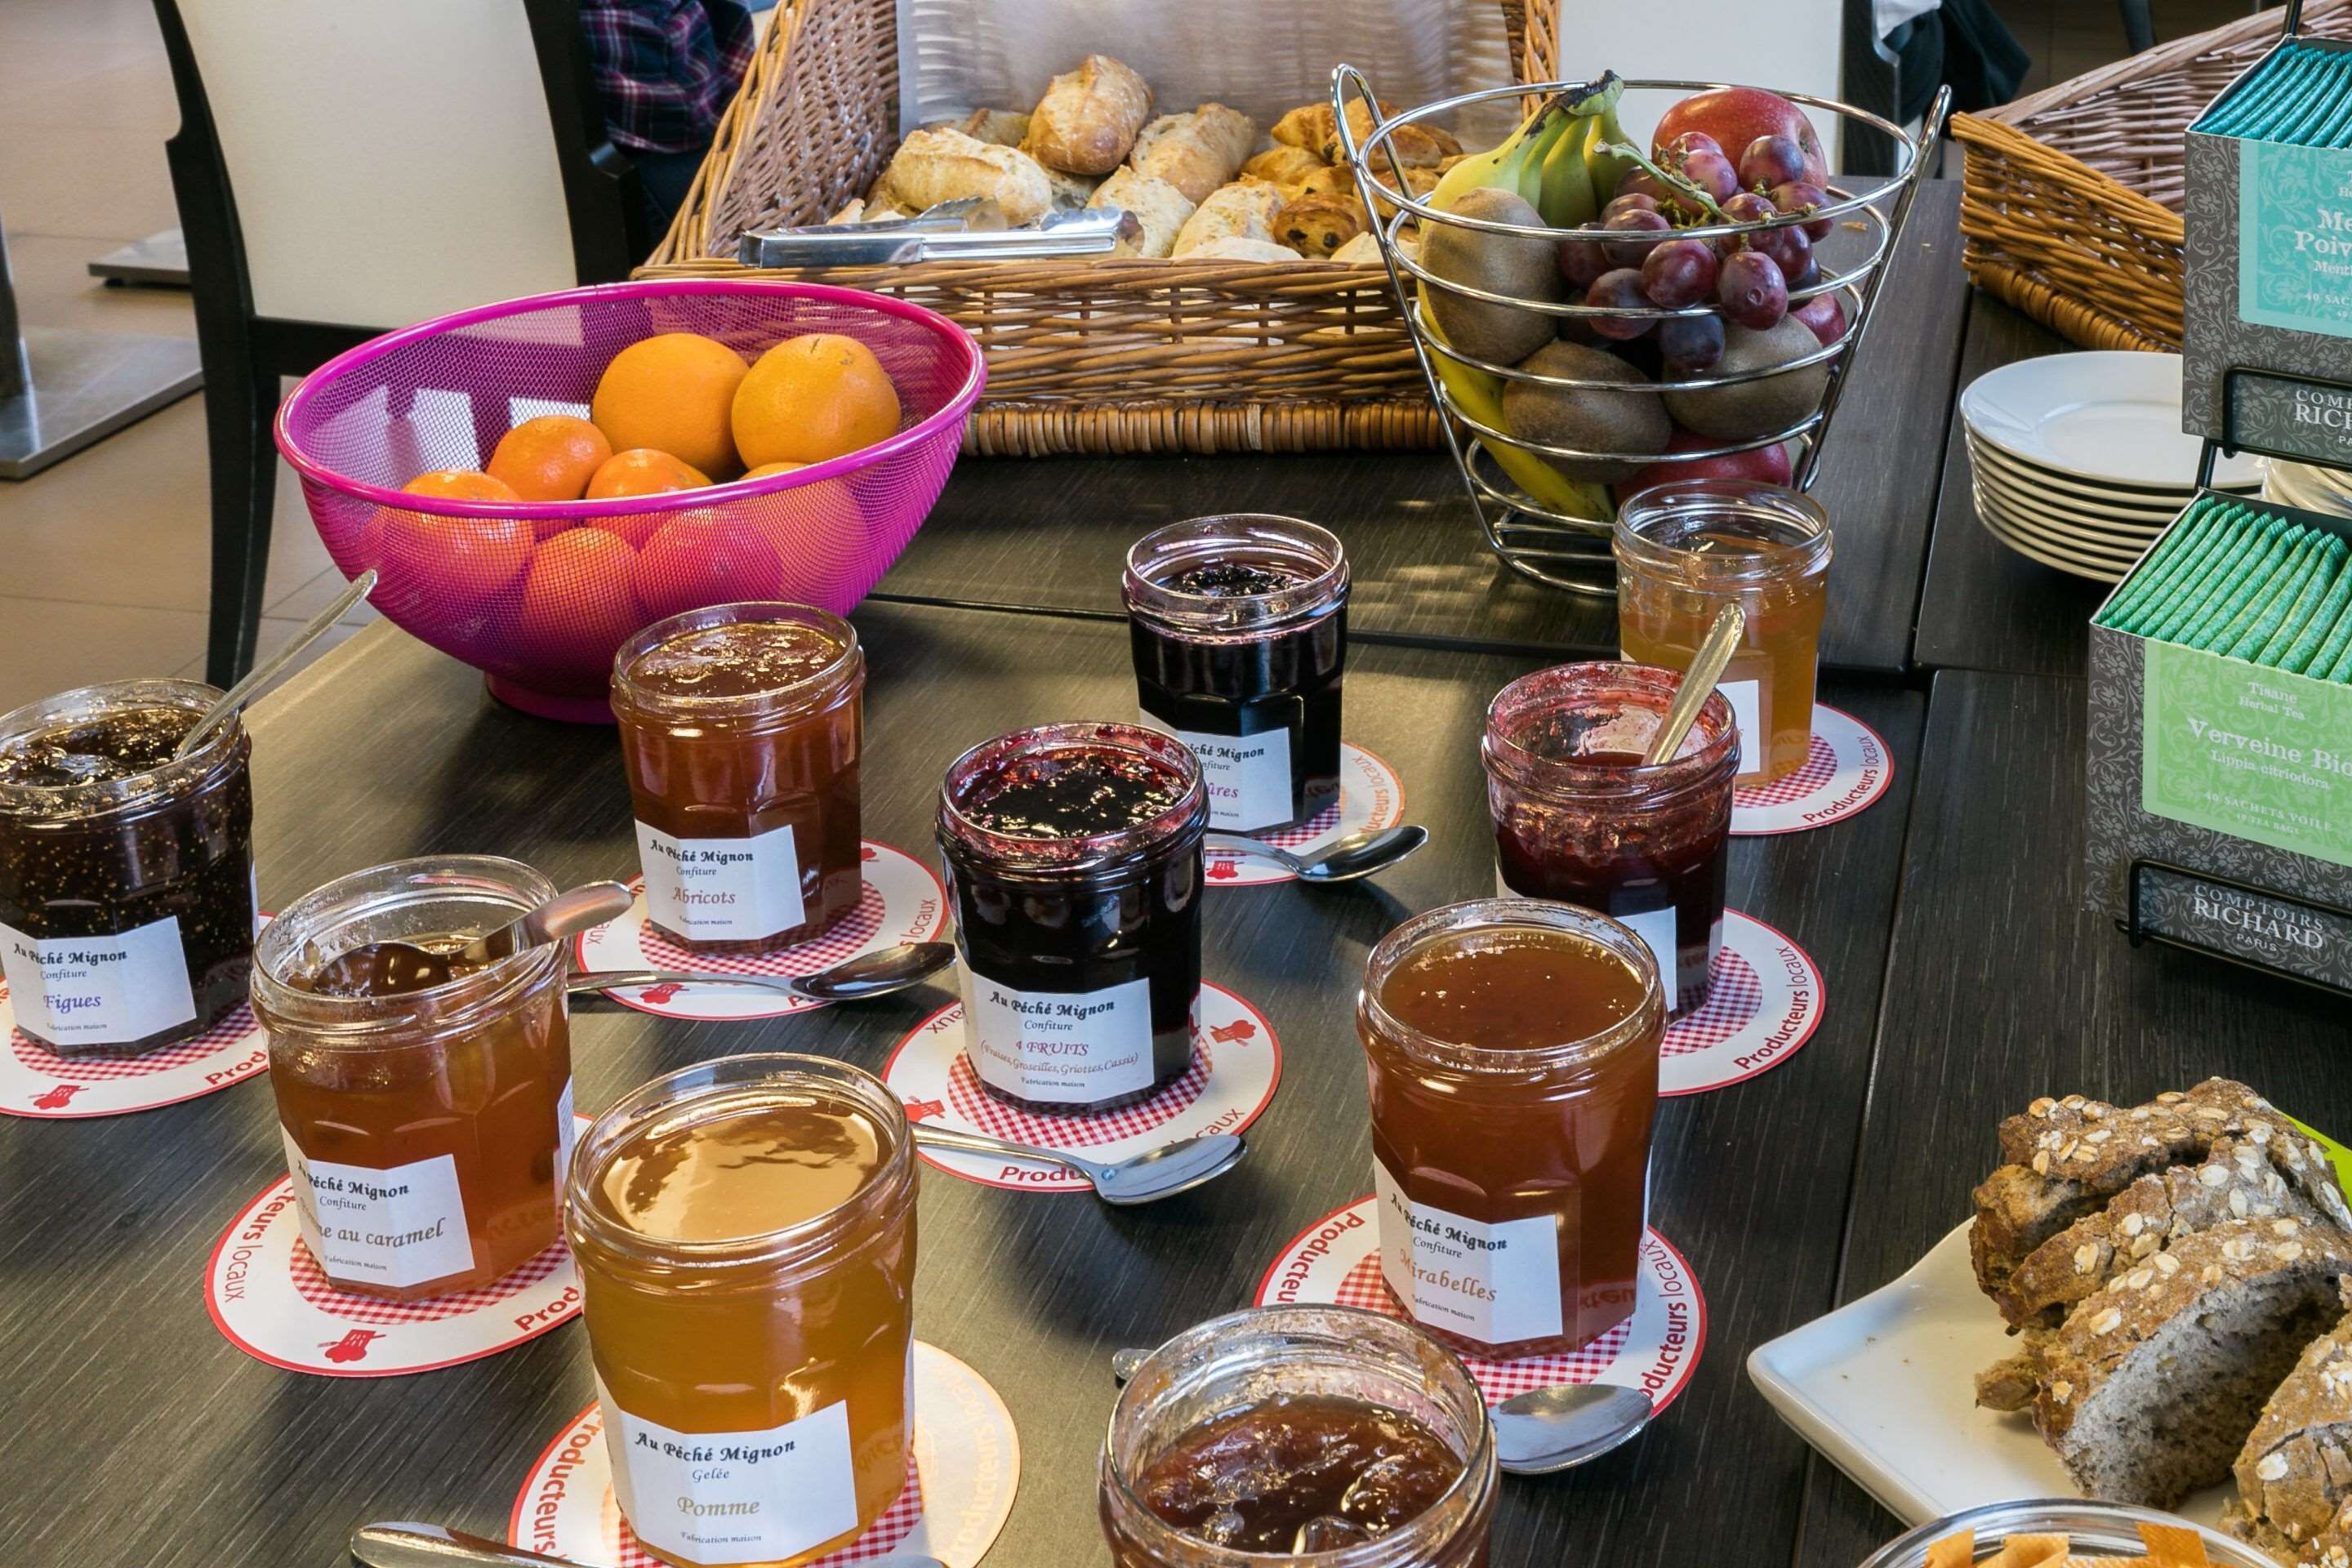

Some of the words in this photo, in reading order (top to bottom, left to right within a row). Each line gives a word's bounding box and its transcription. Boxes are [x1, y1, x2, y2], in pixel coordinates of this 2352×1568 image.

[2294, 229, 2352, 257] Poiv
[2247, 681, 2297, 704] Tisane
[2238, 696, 2278, 713] Herbal
[2283, 706, 2305, 720] Tea
[1216, 747, 1265, 763] Mignon
[2188, 718, 2302, 764] Verveine
[2312, 748, 2352, 777] Bio
[1802, 768, 1878, 822] Producteurs
[1856, 735, 1879, 767] locaux
[2211, 749, 2256, 771] Lippia
[2261, 763, 2330, 791] citriodora
[2224, 795, 2287, 820] SACHETS
[2289, 811, 2332, 831] VOILE
[650, 839, 665, 853] Au
[666, 846, 697, 862] Péché
[700, 850, 755, 866] Mignon
[676, 866, 717, 879] Confiture
[672, 887, 737, 905] Abricots
[2194, 884, 2323, 931] COMPTOIRS
[900, 898, 937, 938] locaux
[2194, 896, 2323, 949] RICHARD
[14, 942, 27, 957] Au
[29, 949, 64, 965] Péché
[68, 950, 127, 966] Mignon
[2236, 933, 2278, 952] PARIS
[41, 969, 87, 982] Confiture
[43, 994, 102, 1014] Figues
[990, 991, 1009, 1008] Au
[1010, 1001, 1052, 1016] Péché
[1057, 1000, 1116, 1021] Mignon
[1733, 990, 1810, 1070] Producteurs
[1775, 946, 1808, 987] locaux
[1024, 1020, 1074, 1033] Confiture
[1015, 1040, 1022, 1051] 4
[1027, 1040, 1089, 1057] FRUITS
[1021, 1076, 1059, 1087] Fabrication
[1061, 1080, 1085, 1088] maison
[319, 1196, 368, 1211] Confiture
[348, 1182, 410, 1201] Mignon
[337, 1228, 361, 1243] au
[366, 1217, 447, 1249] caramel
[1391, 1193, 1402, 1215] Au
[1404, 1209, 1441, 1236] Péché
[1445, 1226, 1508, 1251] Mignon
[1413, 1236, 1463, 1259] Confiture
[225, 1245, 264, 1303] locaux
[325, 1254, 362, 1267] Fabrication
[363, 1262, 387, 1272] maison
[1643, 1239, 1685, 1298] locaux
[1401, 1248, 1498, 1303] Mirabelles
[1411, 1293, 1449, 1314] Fabrication
[1450, 1308, 1475, 1322] maison
[635, 1432, 659, 1450] Au
[663, 1442, 713, 1462] Péché
[719, 1440, 796, 1464] Mignon
[692, 1468, 730, 1483] Gelée
[676, 1495, 760, 1517] Pomme
[680, 1531, 729, 1544] Fabrication
[731, 1535, 762, 1543] maison
